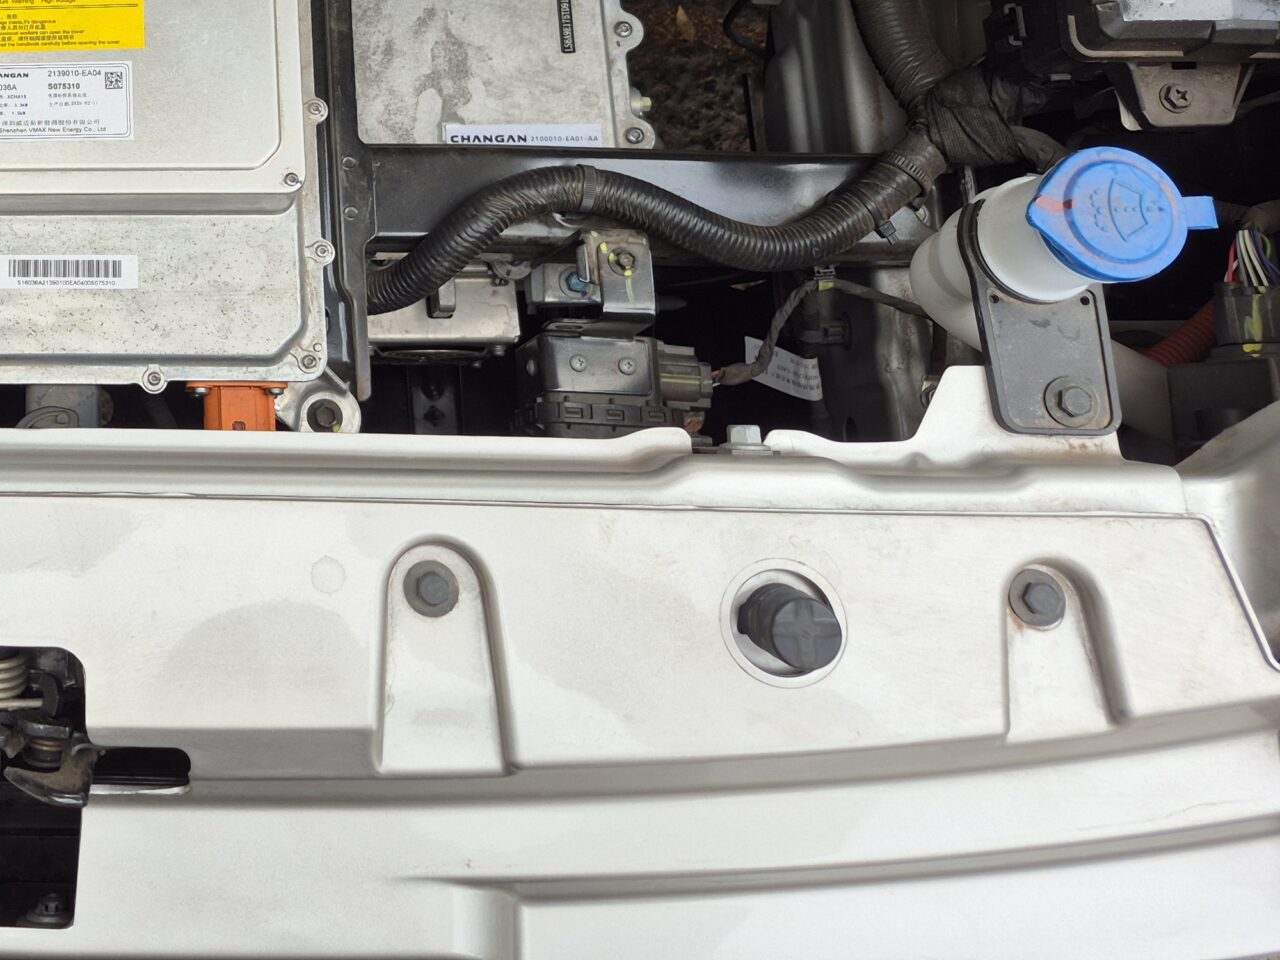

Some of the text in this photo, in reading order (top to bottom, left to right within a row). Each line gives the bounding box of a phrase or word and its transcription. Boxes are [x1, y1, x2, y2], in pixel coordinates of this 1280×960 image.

[47, 70, 102, 78] 2139010-EA04
[47, 82, 80, 90] S075310
[62, 126, 83, 134] Energy
[450, 134, 528, 143] CHANGAN
